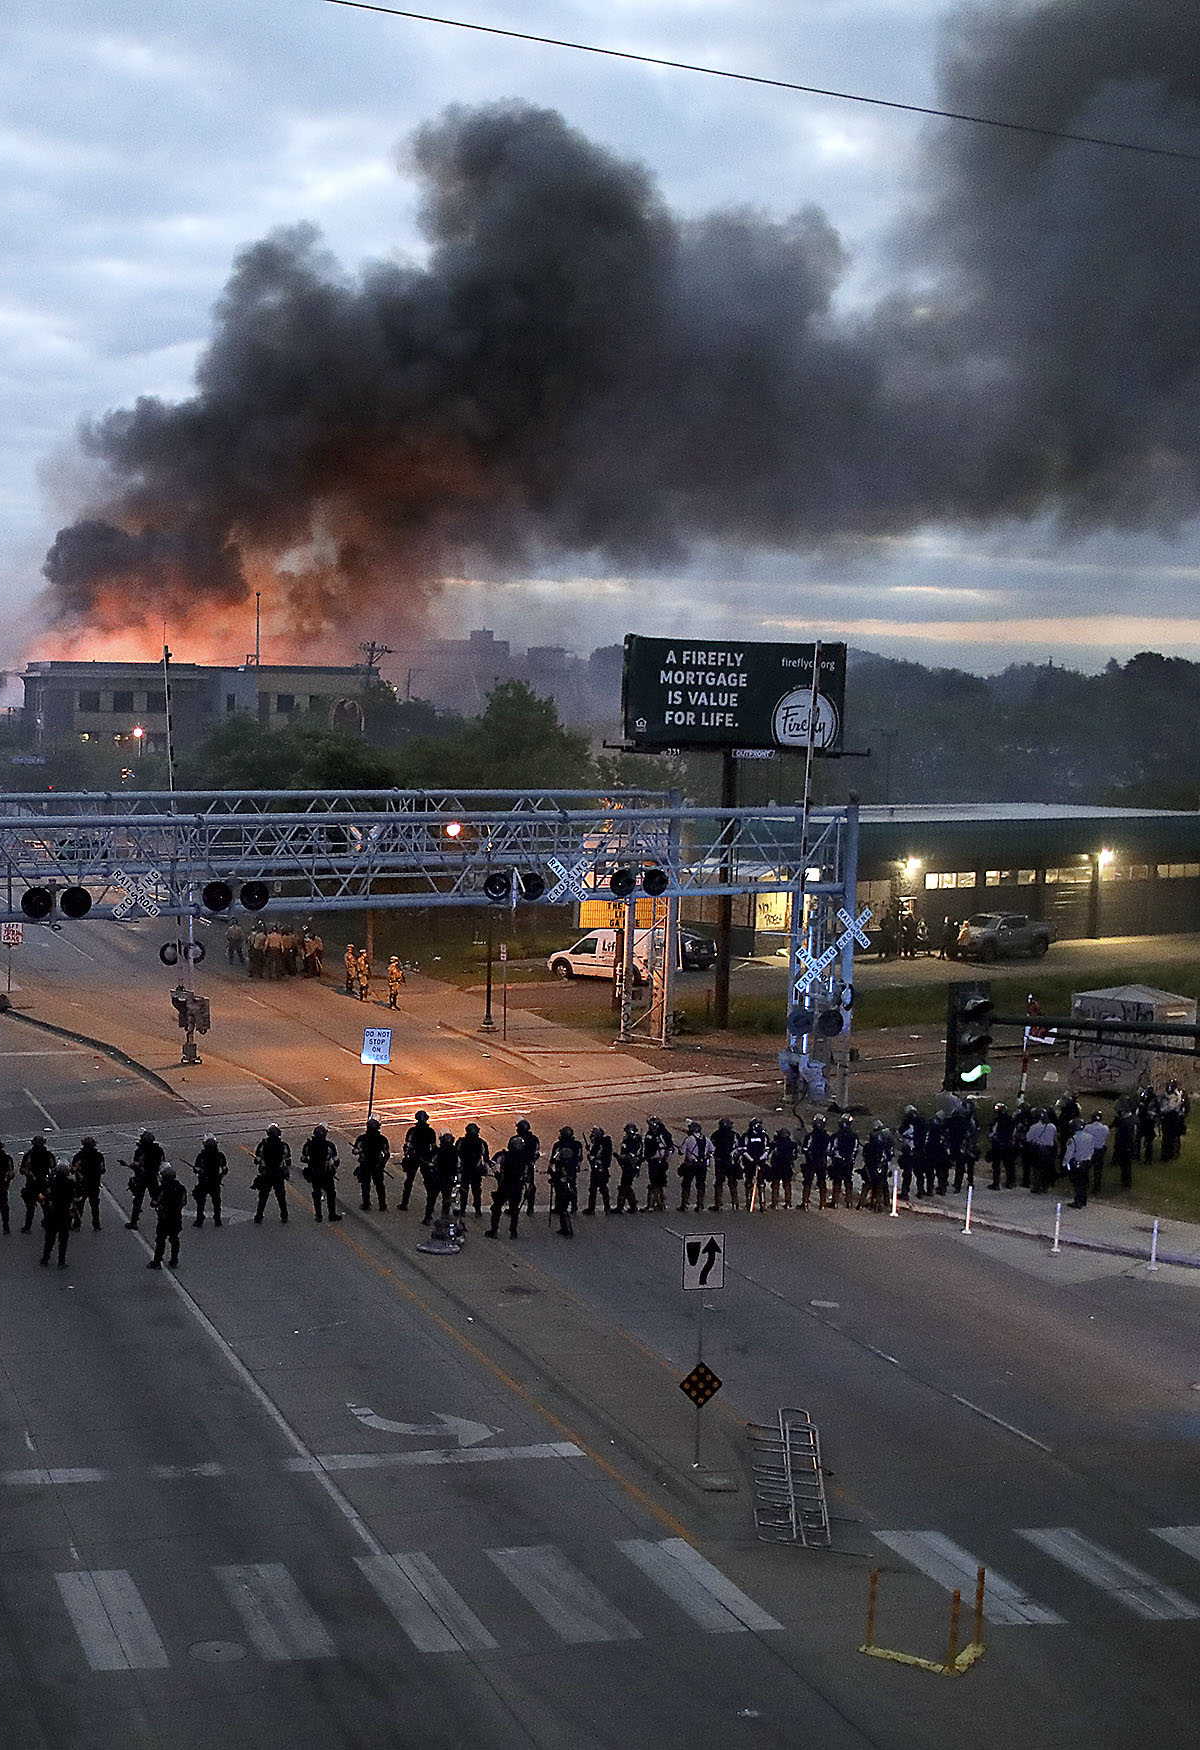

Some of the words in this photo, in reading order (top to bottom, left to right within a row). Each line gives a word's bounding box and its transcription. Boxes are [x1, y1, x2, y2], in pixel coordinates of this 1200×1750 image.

[666, 651, 677, 665] A
[682, 651, 744, 667] FIREFLY
[781, 657, 836, 671] fireflycorg
[660, 671, 748, 687] MORTGAGE
[667, 691, 682, 705] IS
[687, 692, 739, 707] VALUE
[664, 711, 696, 726] FOR
[701, 713, 739, 727] LIFE.
